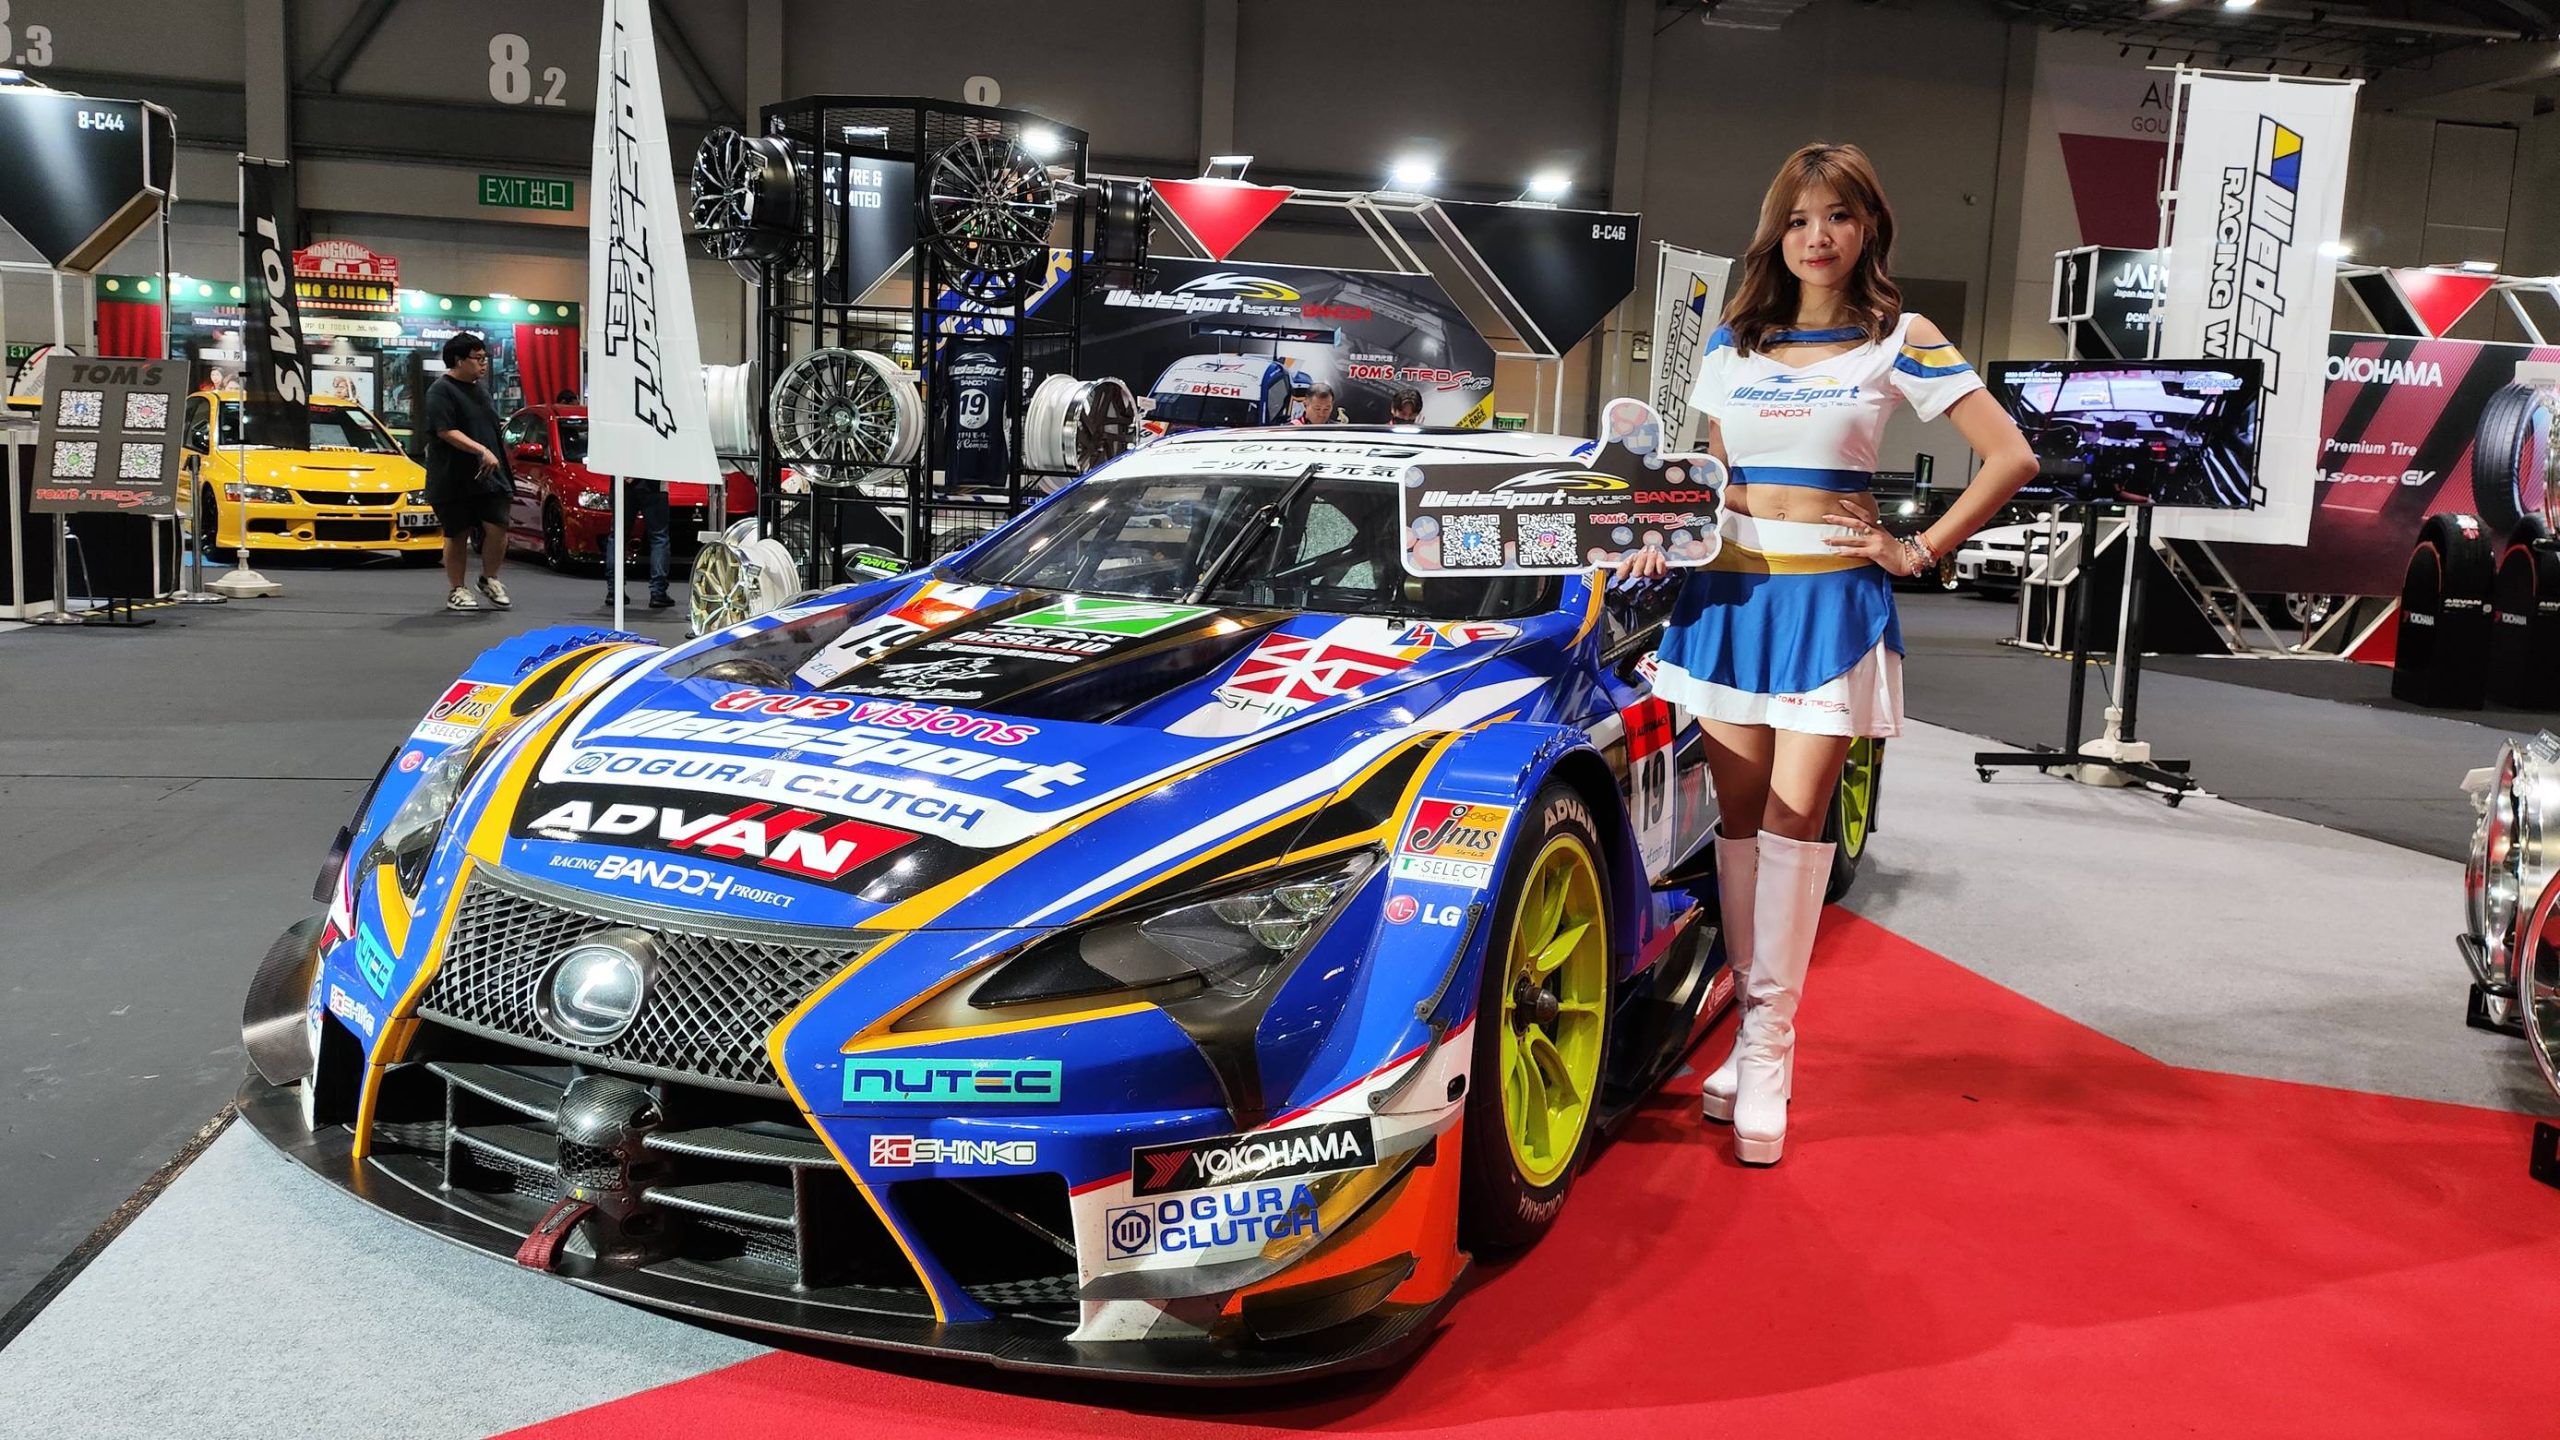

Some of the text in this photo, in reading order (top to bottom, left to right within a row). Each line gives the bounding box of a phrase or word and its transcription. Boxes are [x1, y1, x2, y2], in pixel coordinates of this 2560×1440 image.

[489, 33, 567, 106] 8.2
[77, 110, 125, 132] 8-C44
[486, 178, 526, 205] EXIT
[873, 170, 882, 188] &
[530, 181, 566, 209] 出口
[1592, 224, 1627, 241] 8-C46
[2207, 167, 2247, 310] RACING
[328, 285, 388, 301] CINEMA
[1104, 289, 1244, 314] WedsSport
[1661, 300, 1684, 380] RACING
[72, 363, 163, 386] TOM'S
[1349, 365, 1394, 381] TOM'S
[1402, 368, 1451, 383] TRD
[2325, 356, 2444, 388] OKOHAMA
[1191, 384, 1241, 397] BOSCH
[1732, 384, 1860, 404] WedsSport
[960, 394, 986, 416] 19
[2325, 438, 2417, 456] Premium Tire
[35, 488, 80, 500] TOM'S
[1419, 489, 1568, 510] WedsSport
[1589, 513, 1628, 525] TOM'S
[1635, 513, 1677, 523] TRD
[856, 555, 903, 573] DRIVE
[985, 626, 1124, 643] JAPAN
[713, 687, 1041, 745] true visions
[577, 707, 1087, 797] WedsSport
[607, 753, 987, 831] OGURA CLUTCH
[1641, 749, 1666, 832] 19
[1411, 805, 1498, 851] jms
[1544, 798, 1598, 846] ADVAN
[527, 800, 858, 875] ADVAN
[1401, 857, 1489, 880] T-SELECT
[548, 854, 599, 871] RACING
[729, 884, 795, 909] PROJECT
[1421, 902, 1464, 928] LG
[853, 1069, 1053, 1094] NUTEC
[914, 1140, 1036, 1164] SHINKO
[1192, 1129, 1364, 1179] YOKOHAMA
[1157, 1183, 1319, 1225] OGURA
[1159, 1208, 1321, 1253] CLUTCH
